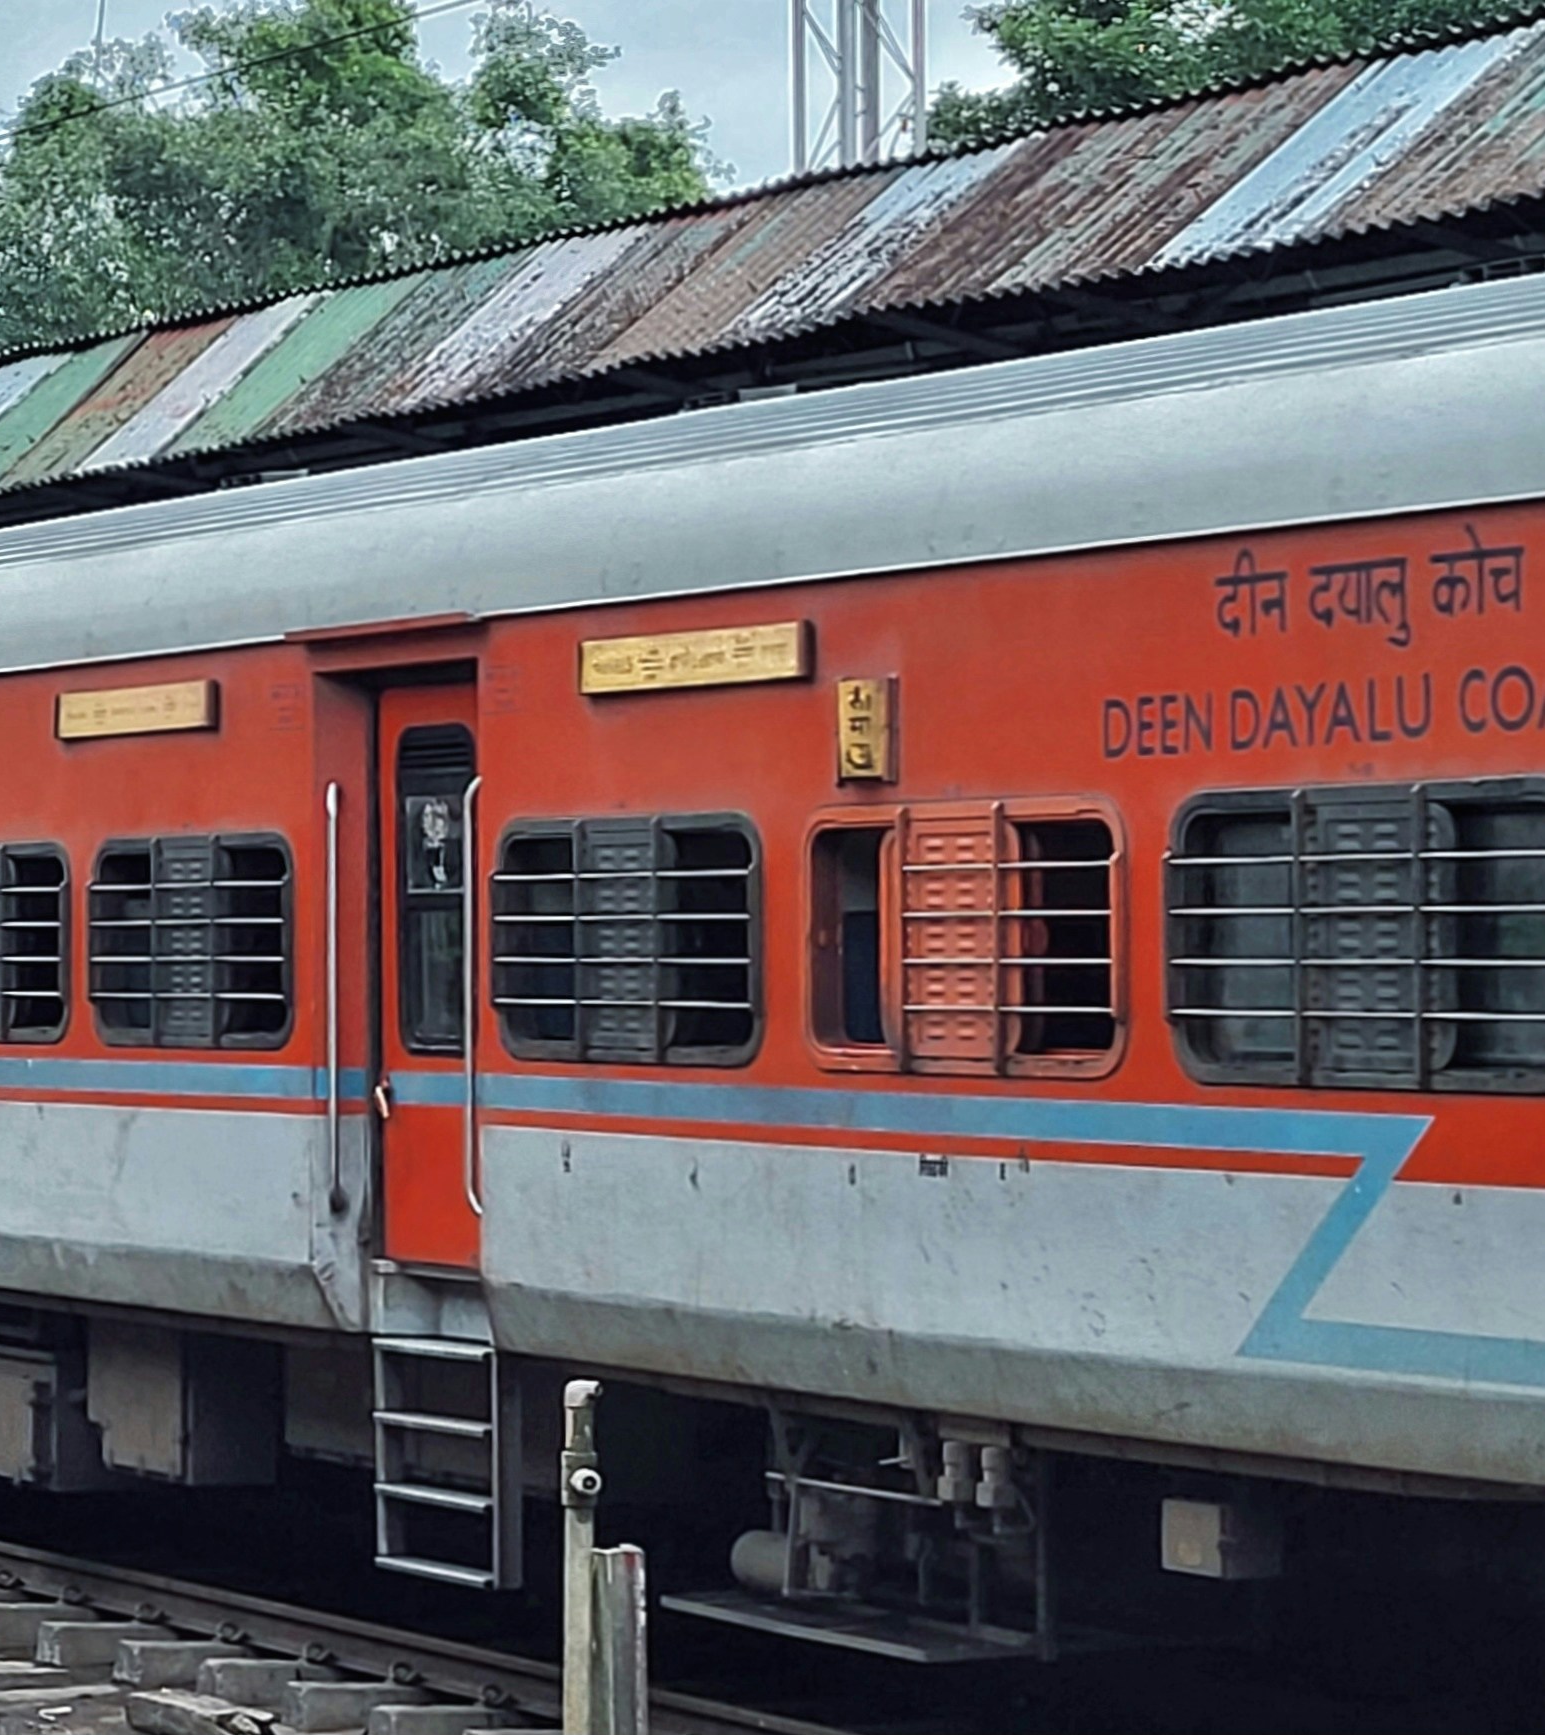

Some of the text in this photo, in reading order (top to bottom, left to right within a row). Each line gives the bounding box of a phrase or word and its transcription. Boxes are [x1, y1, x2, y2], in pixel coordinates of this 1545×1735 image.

[1214, 524, 1524, 647] दीन दयालु कोच
[1103, 666, 1545, 758] DEEN DAYALU CO
